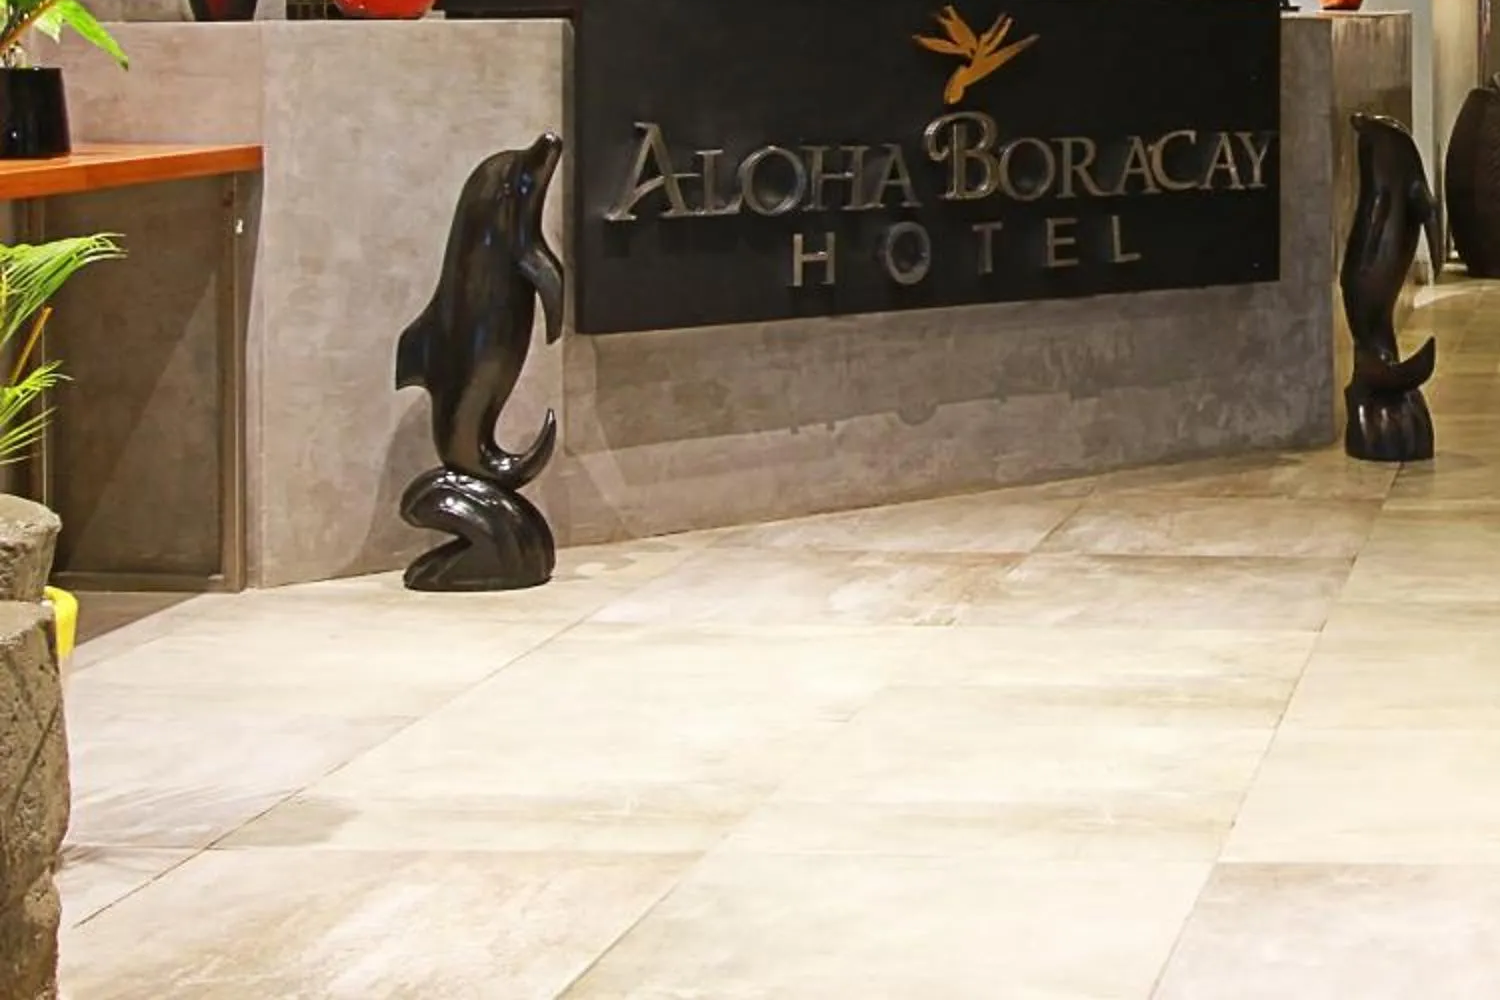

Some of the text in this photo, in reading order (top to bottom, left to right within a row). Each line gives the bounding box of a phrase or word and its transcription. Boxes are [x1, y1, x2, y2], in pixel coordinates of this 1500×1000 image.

[603, 111, 1276, 221] ALOHA BORACAY
[792, 215, 1142, 287] HOTEL
